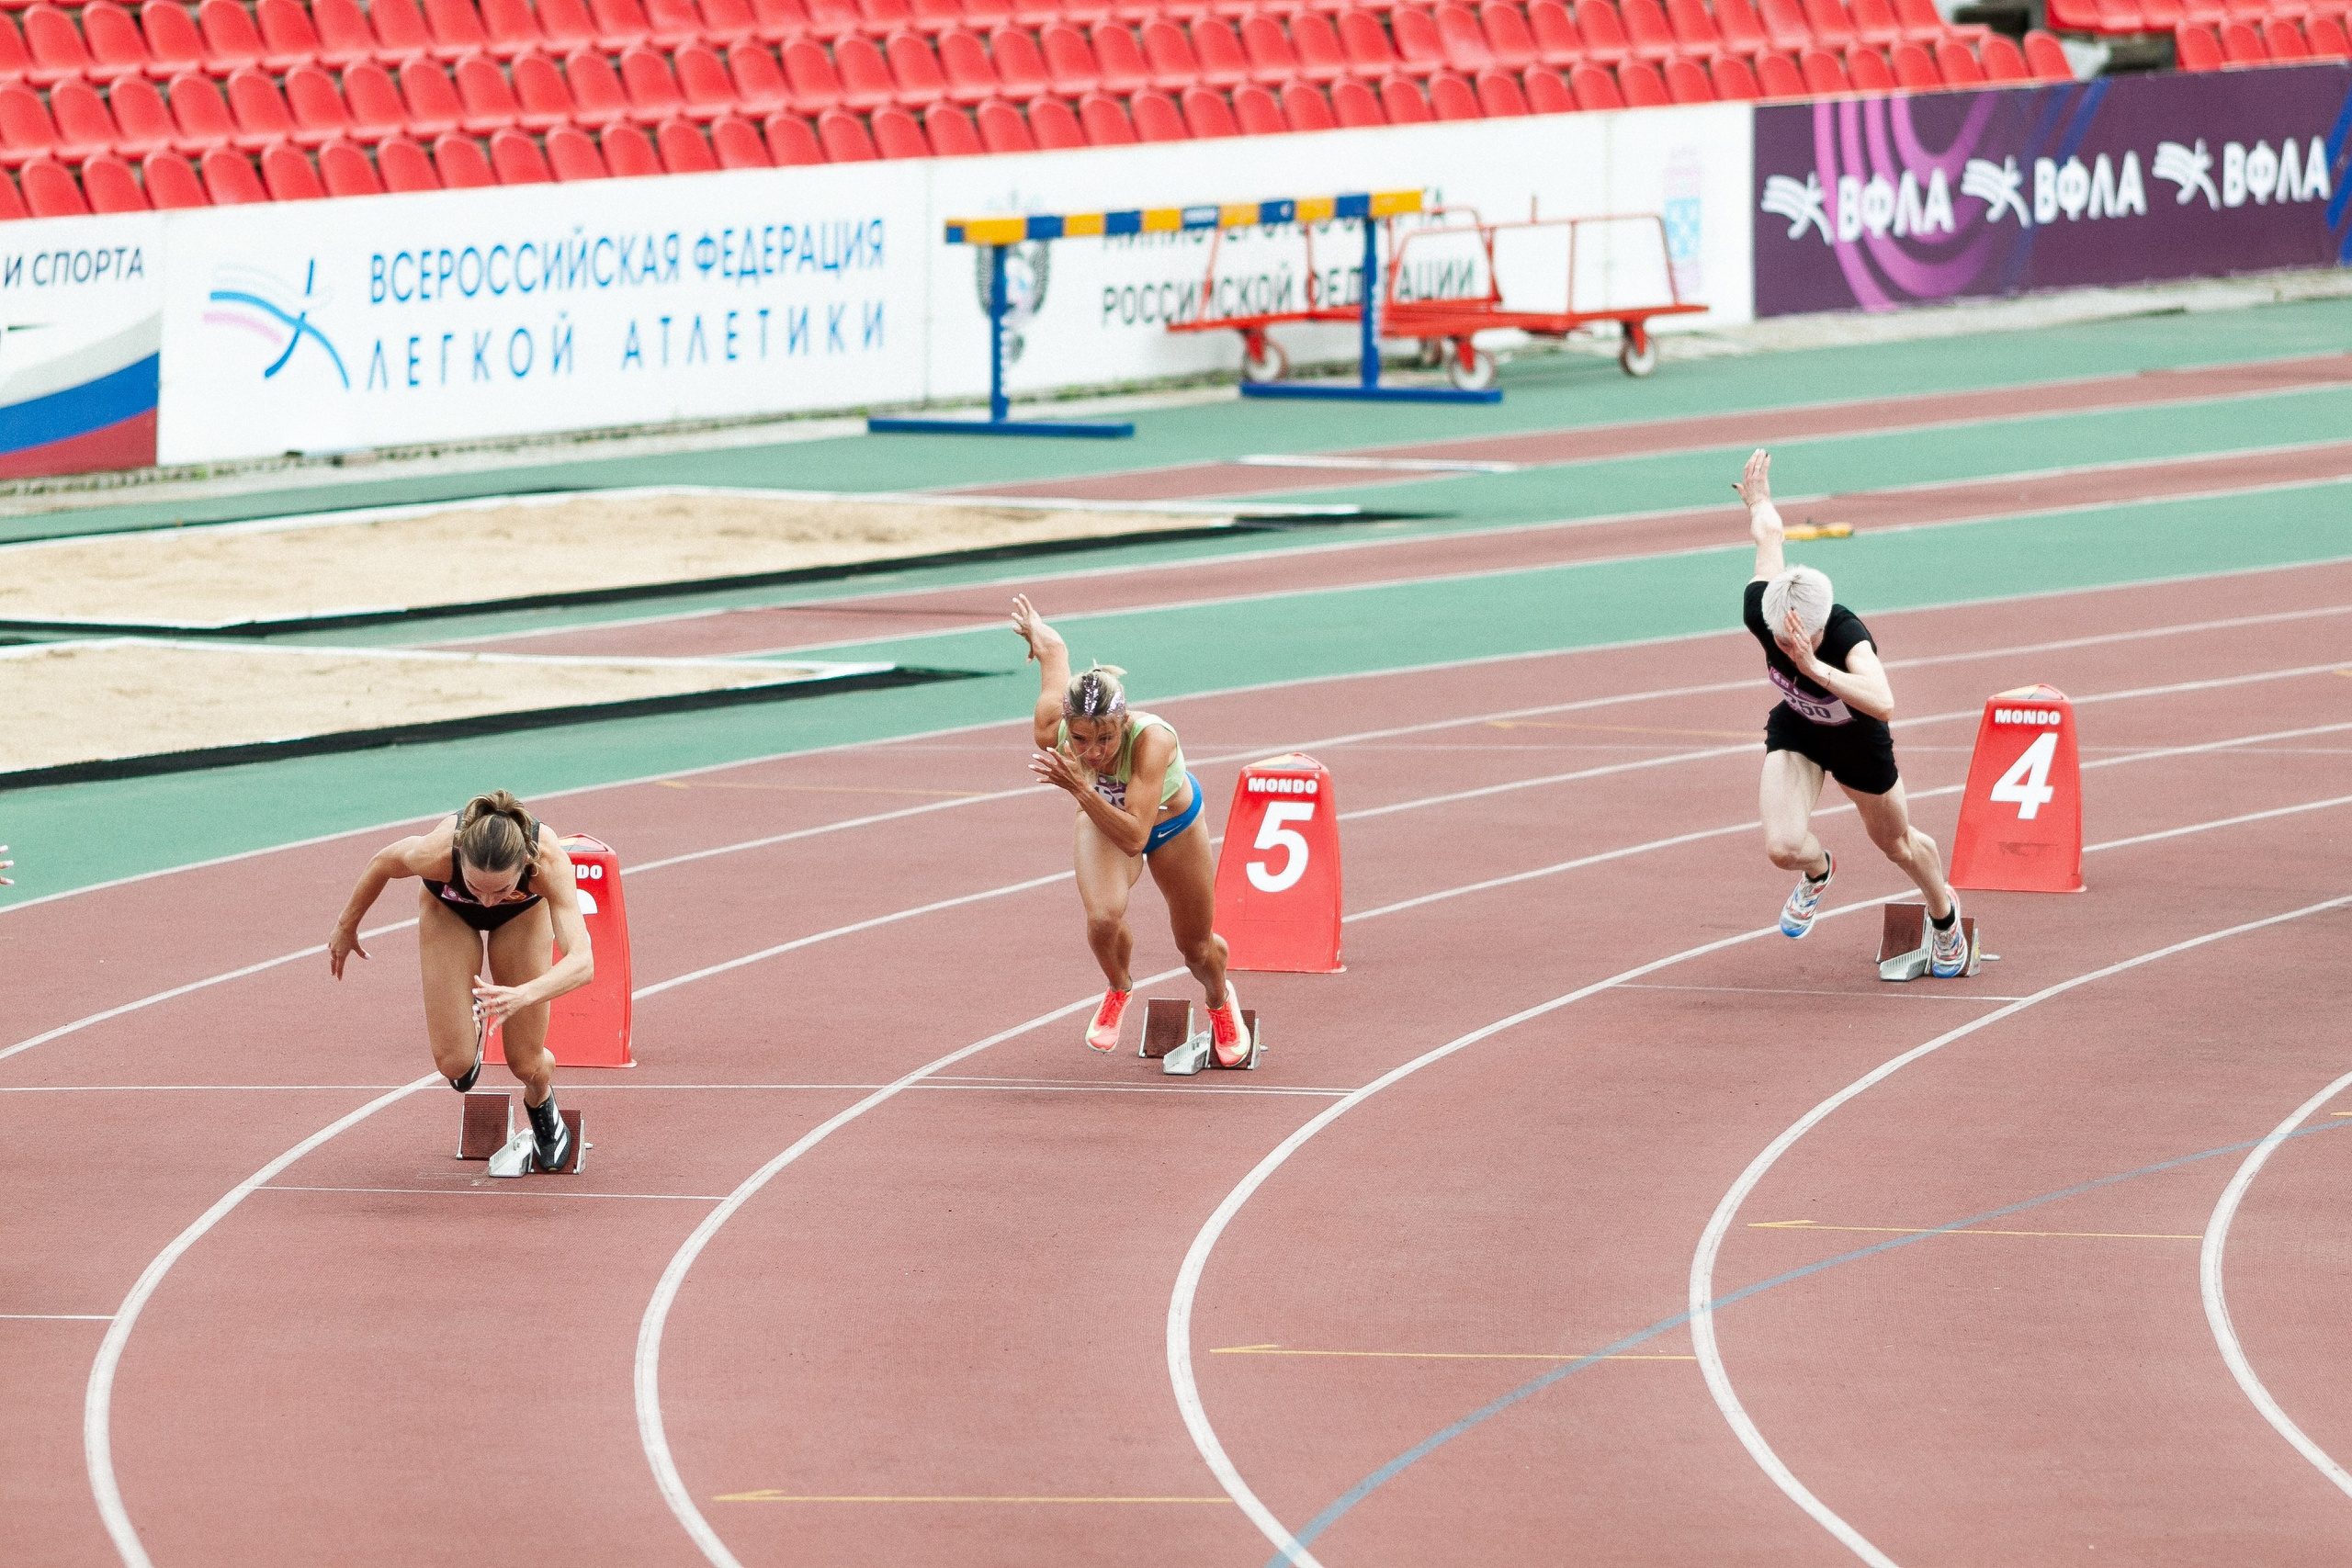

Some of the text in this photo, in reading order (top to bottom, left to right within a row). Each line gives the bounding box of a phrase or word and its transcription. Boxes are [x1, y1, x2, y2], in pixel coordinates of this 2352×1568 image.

[1837, 134, 2332, 243] ВФЛА ВФЛА ВФЛА
[5, 246, 144, 288] И СПОРТА
[370, 218, 885, 305] ВСЕРОССИЙСКАЯ ФЕДЕРАЦИЯ
[368, 300, 885, 391] ЛЕГКОЙ АТЛЕТИКИ
[1995, 709, 2062, 726] MONDO
[1248, 777, 1318, 795] MONDO
[1989, 731, 2059, 820] 4
[1246, 800, 1316, 894] 5
